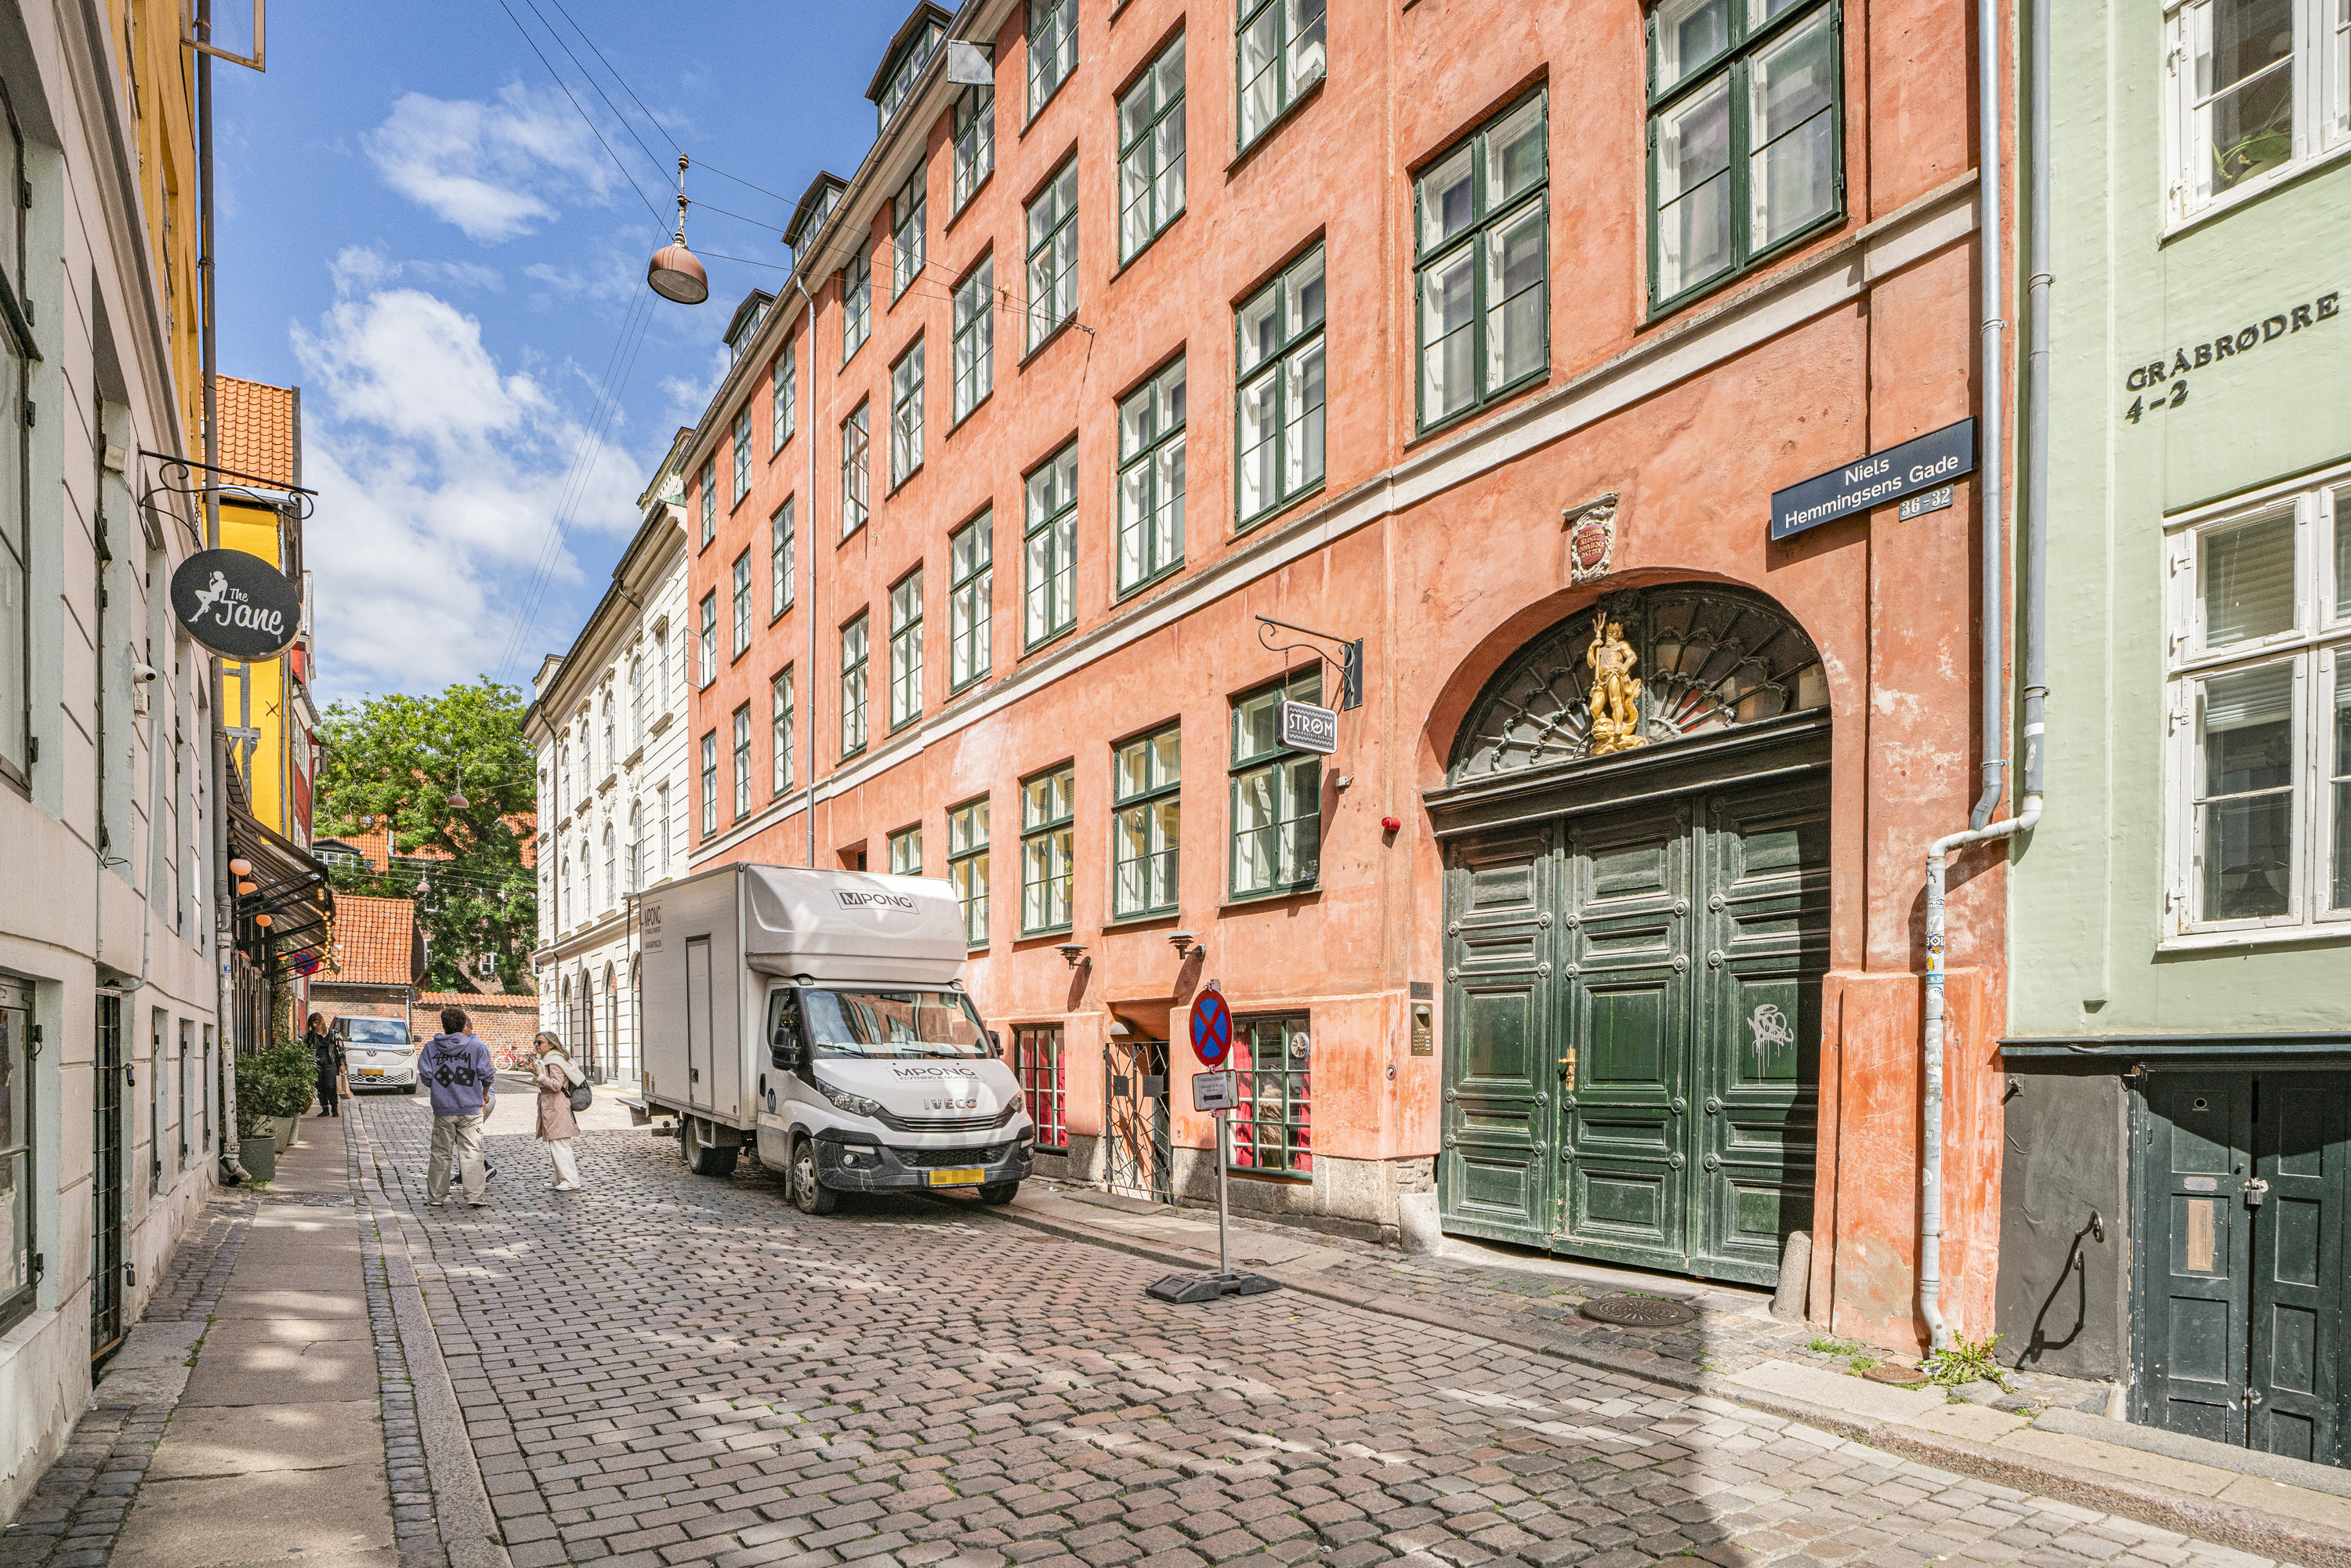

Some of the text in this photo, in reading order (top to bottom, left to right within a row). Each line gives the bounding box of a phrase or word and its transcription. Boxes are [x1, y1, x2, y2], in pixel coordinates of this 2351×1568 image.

[2126, 292, 2339, 392] GRÅBRØDRE
[1845, 457, 1890, 486] Niels
[1785, 455, 1959, 529] Hemmingsens Gade
[230, 588, 248, 602] The
[216, 600, 284, 636] Jane
[1289, 713, 1332, 737] STRØM
[839, 893, 913, 908] MPONG
[644, 905, 661, 927] MPONG
[893, 1067, 976, 1077] MPONG
[923, 1098, 977, 1110] IVECO
